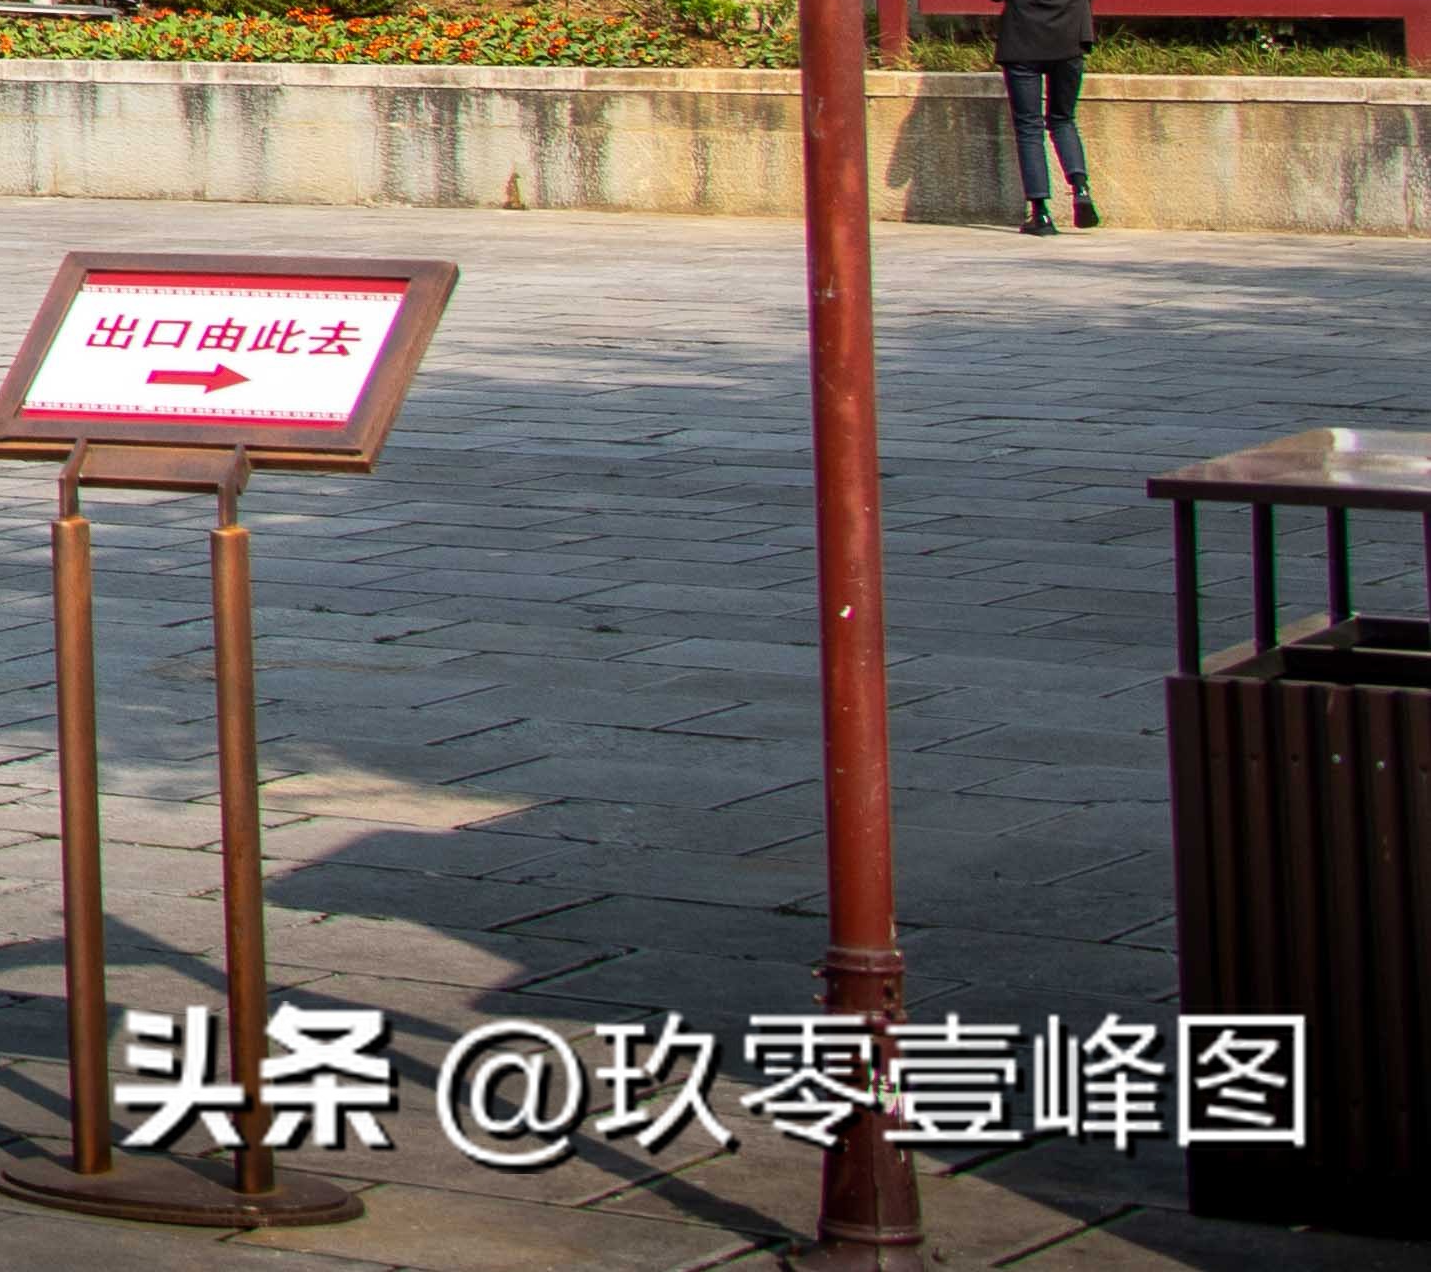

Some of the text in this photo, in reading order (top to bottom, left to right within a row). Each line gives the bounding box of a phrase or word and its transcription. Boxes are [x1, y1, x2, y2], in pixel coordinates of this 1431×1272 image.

[86, 314, 361, 357] 出口由此去
